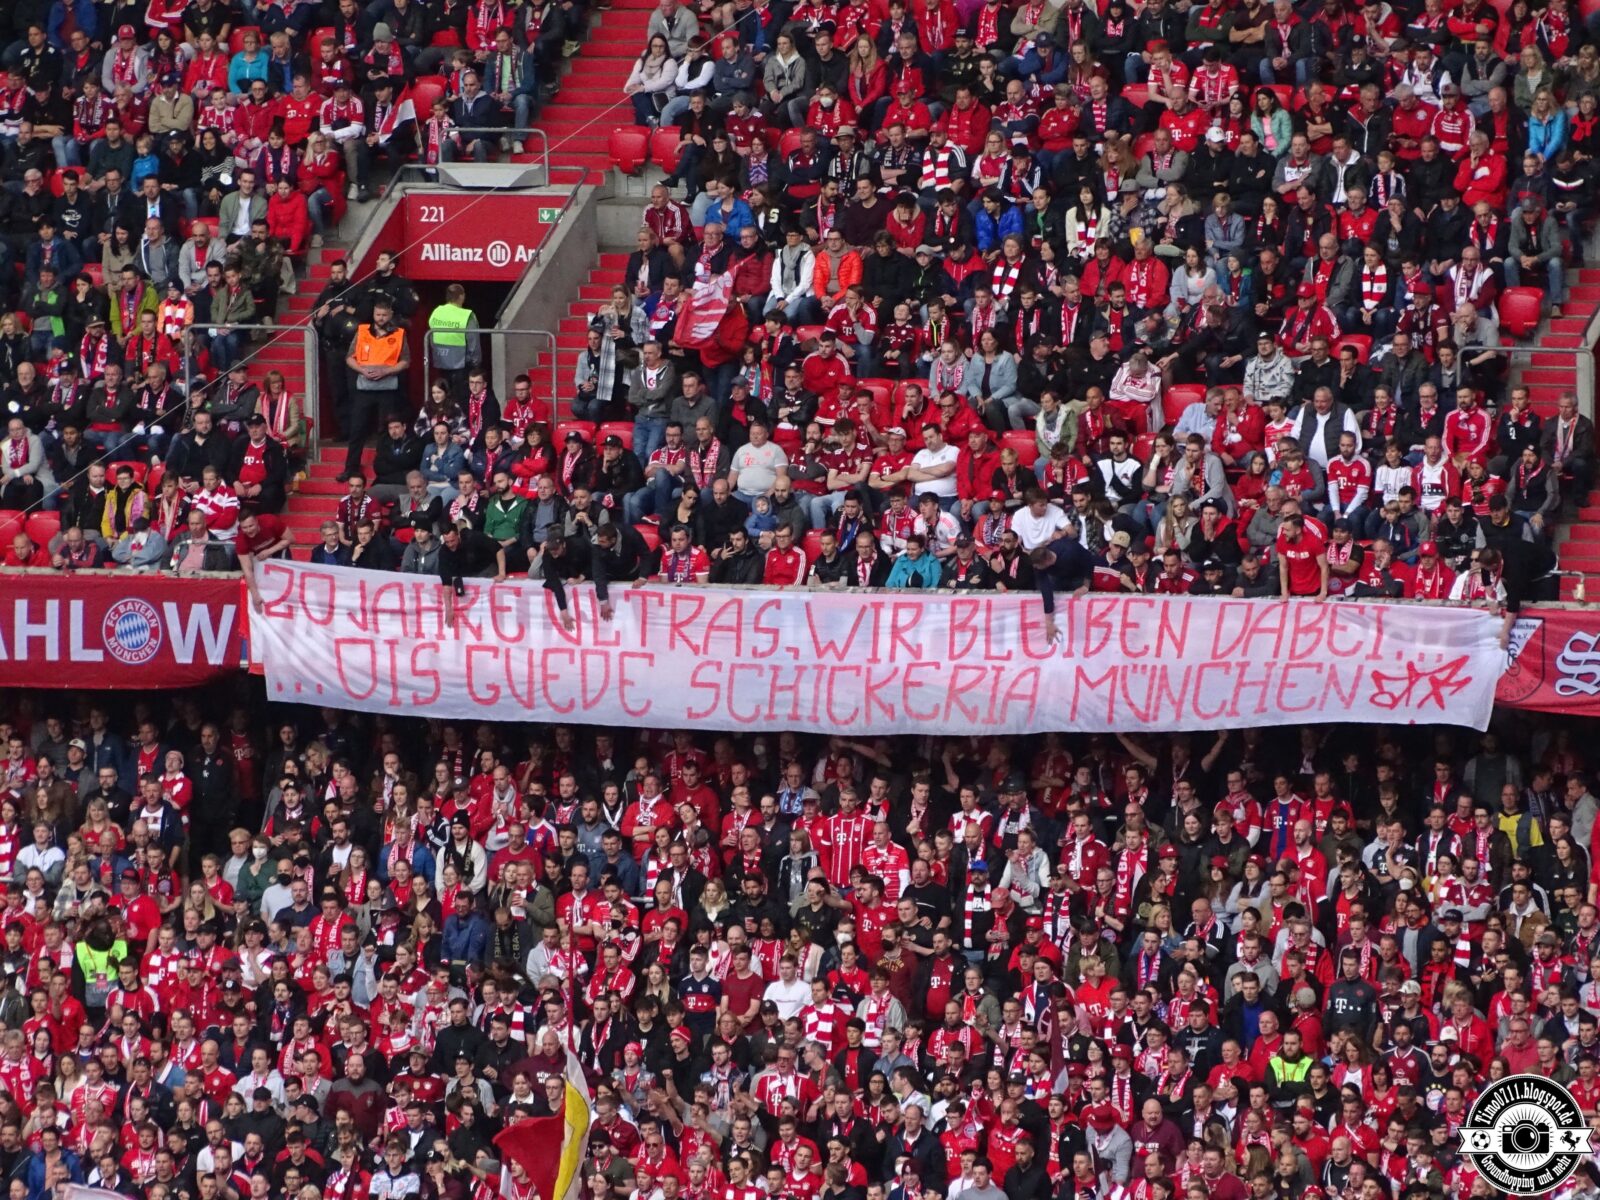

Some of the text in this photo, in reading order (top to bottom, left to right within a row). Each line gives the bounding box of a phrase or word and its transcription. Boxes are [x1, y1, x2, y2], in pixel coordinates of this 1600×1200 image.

[420, 206, 444, 222] 221
[421, 243, 483, 262] Allianz
[0, 599, 104, 662] HL
[107, 602, 159, 628] FC BAYERN
[162, 601, 237, 665] W
[264, 564, 336, 626] 20
[347, 579, 526, 643] JAHRE
[805, 600, 925, 664] WIR
[948, 597, 1192, 661] BLEIBEN
[687, 660, 1041, 726] SCHICKERIA
[1070, 660, 1364, 725] MÜNCHEN
[1335, 998, 1347, 1014] T
